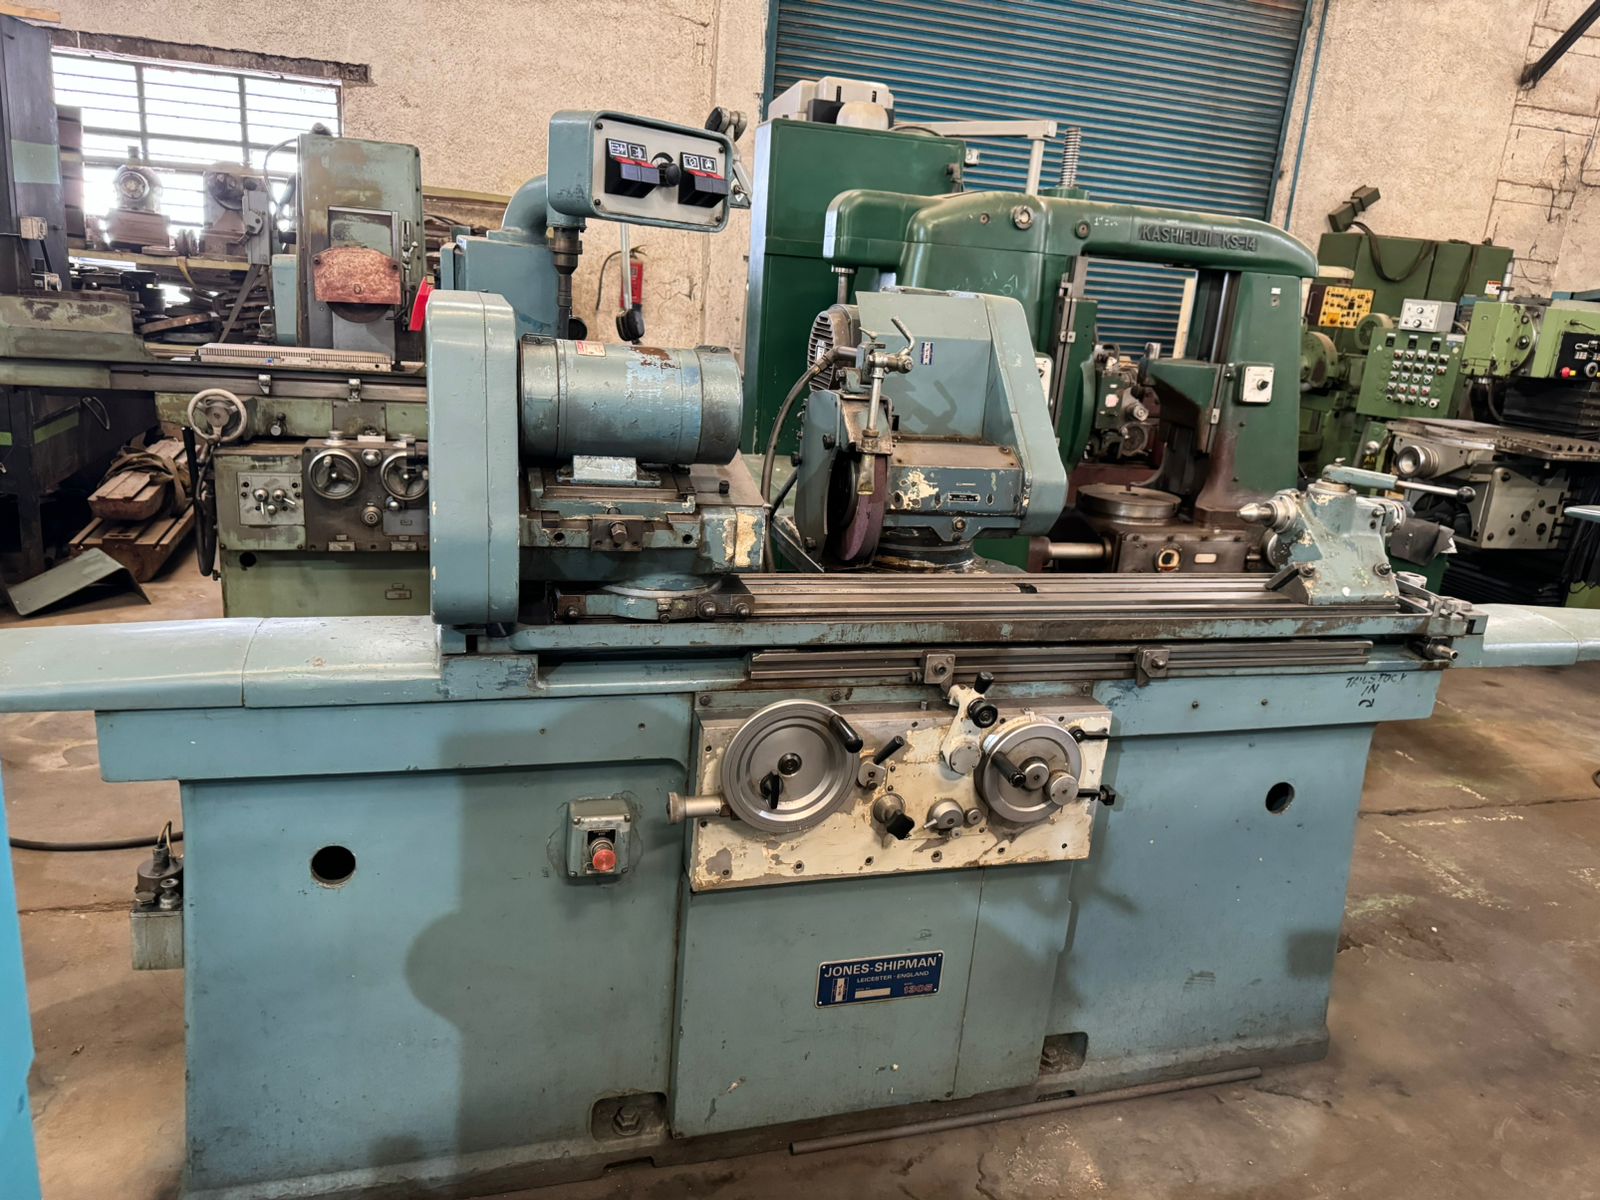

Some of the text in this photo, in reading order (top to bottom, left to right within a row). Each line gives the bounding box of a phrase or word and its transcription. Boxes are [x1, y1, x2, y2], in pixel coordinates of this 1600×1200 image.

[1141, 224, 1257, 252] KASHIFUJI KS-14
[1361, 684, 1380, 697] IN
[824, 956, 937, 978] JONES-SHIPMAN
[857, 969, 930, 984] LEICESTER ENGLAND
